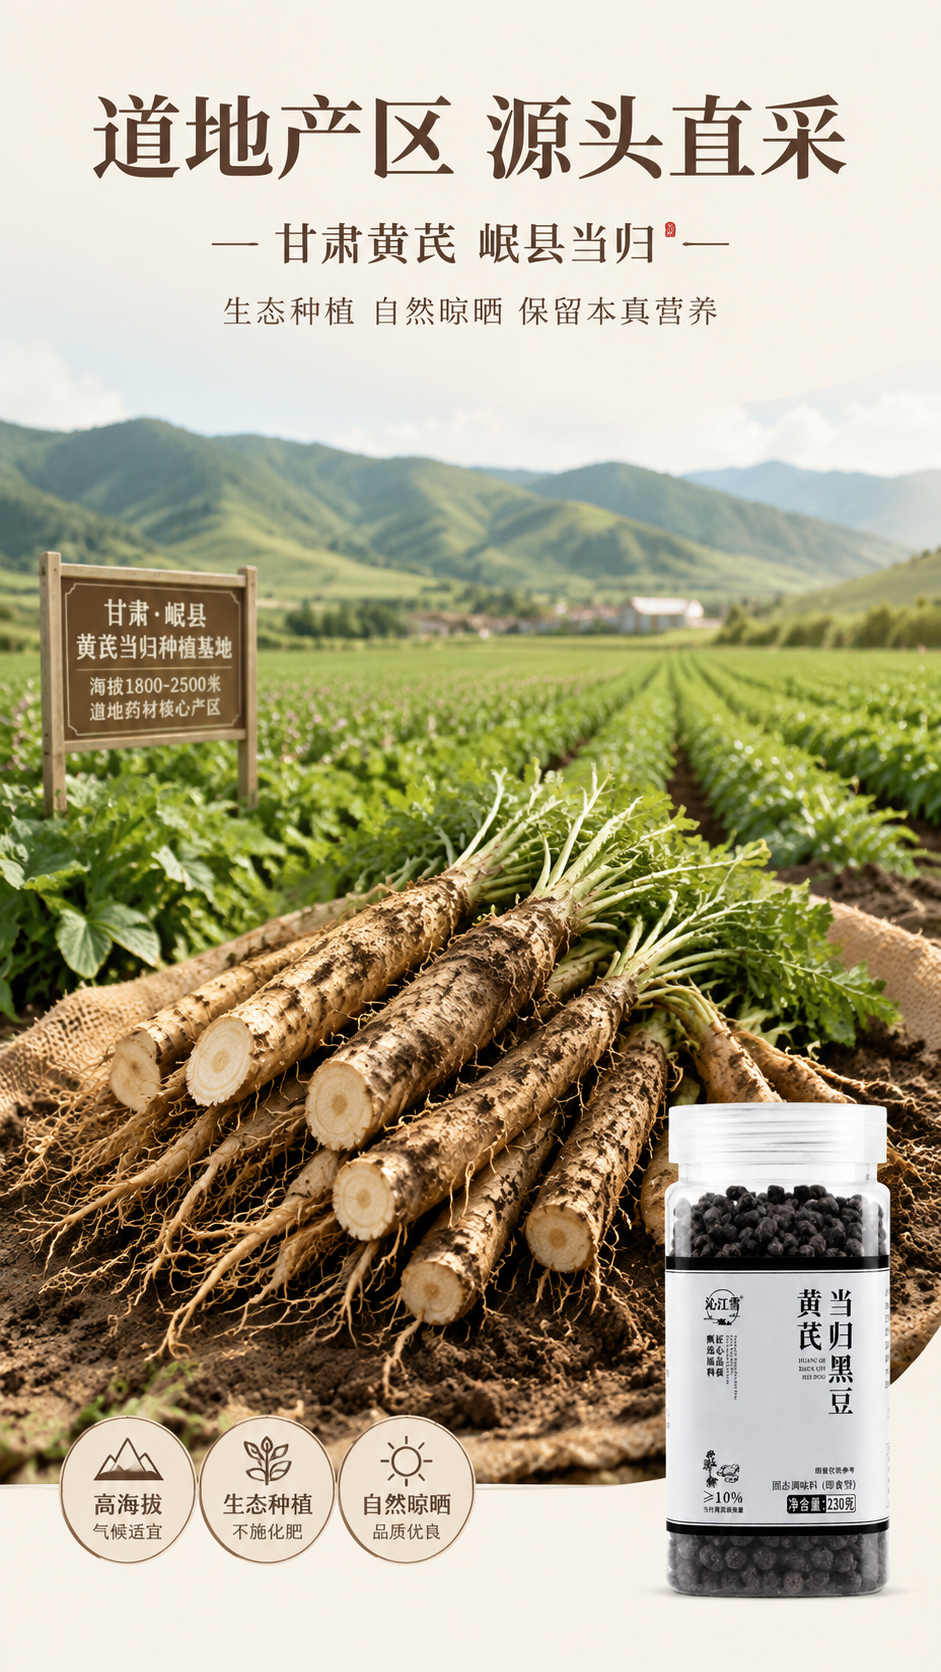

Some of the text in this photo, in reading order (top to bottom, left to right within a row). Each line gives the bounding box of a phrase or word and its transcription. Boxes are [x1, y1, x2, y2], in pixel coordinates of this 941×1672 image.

[76, 633, 233, 661] 黄芪当归种植基地
[797, 1289, 823, 1351] 黄芪
[828, 1288, 854, 1415] 当归黑豆
